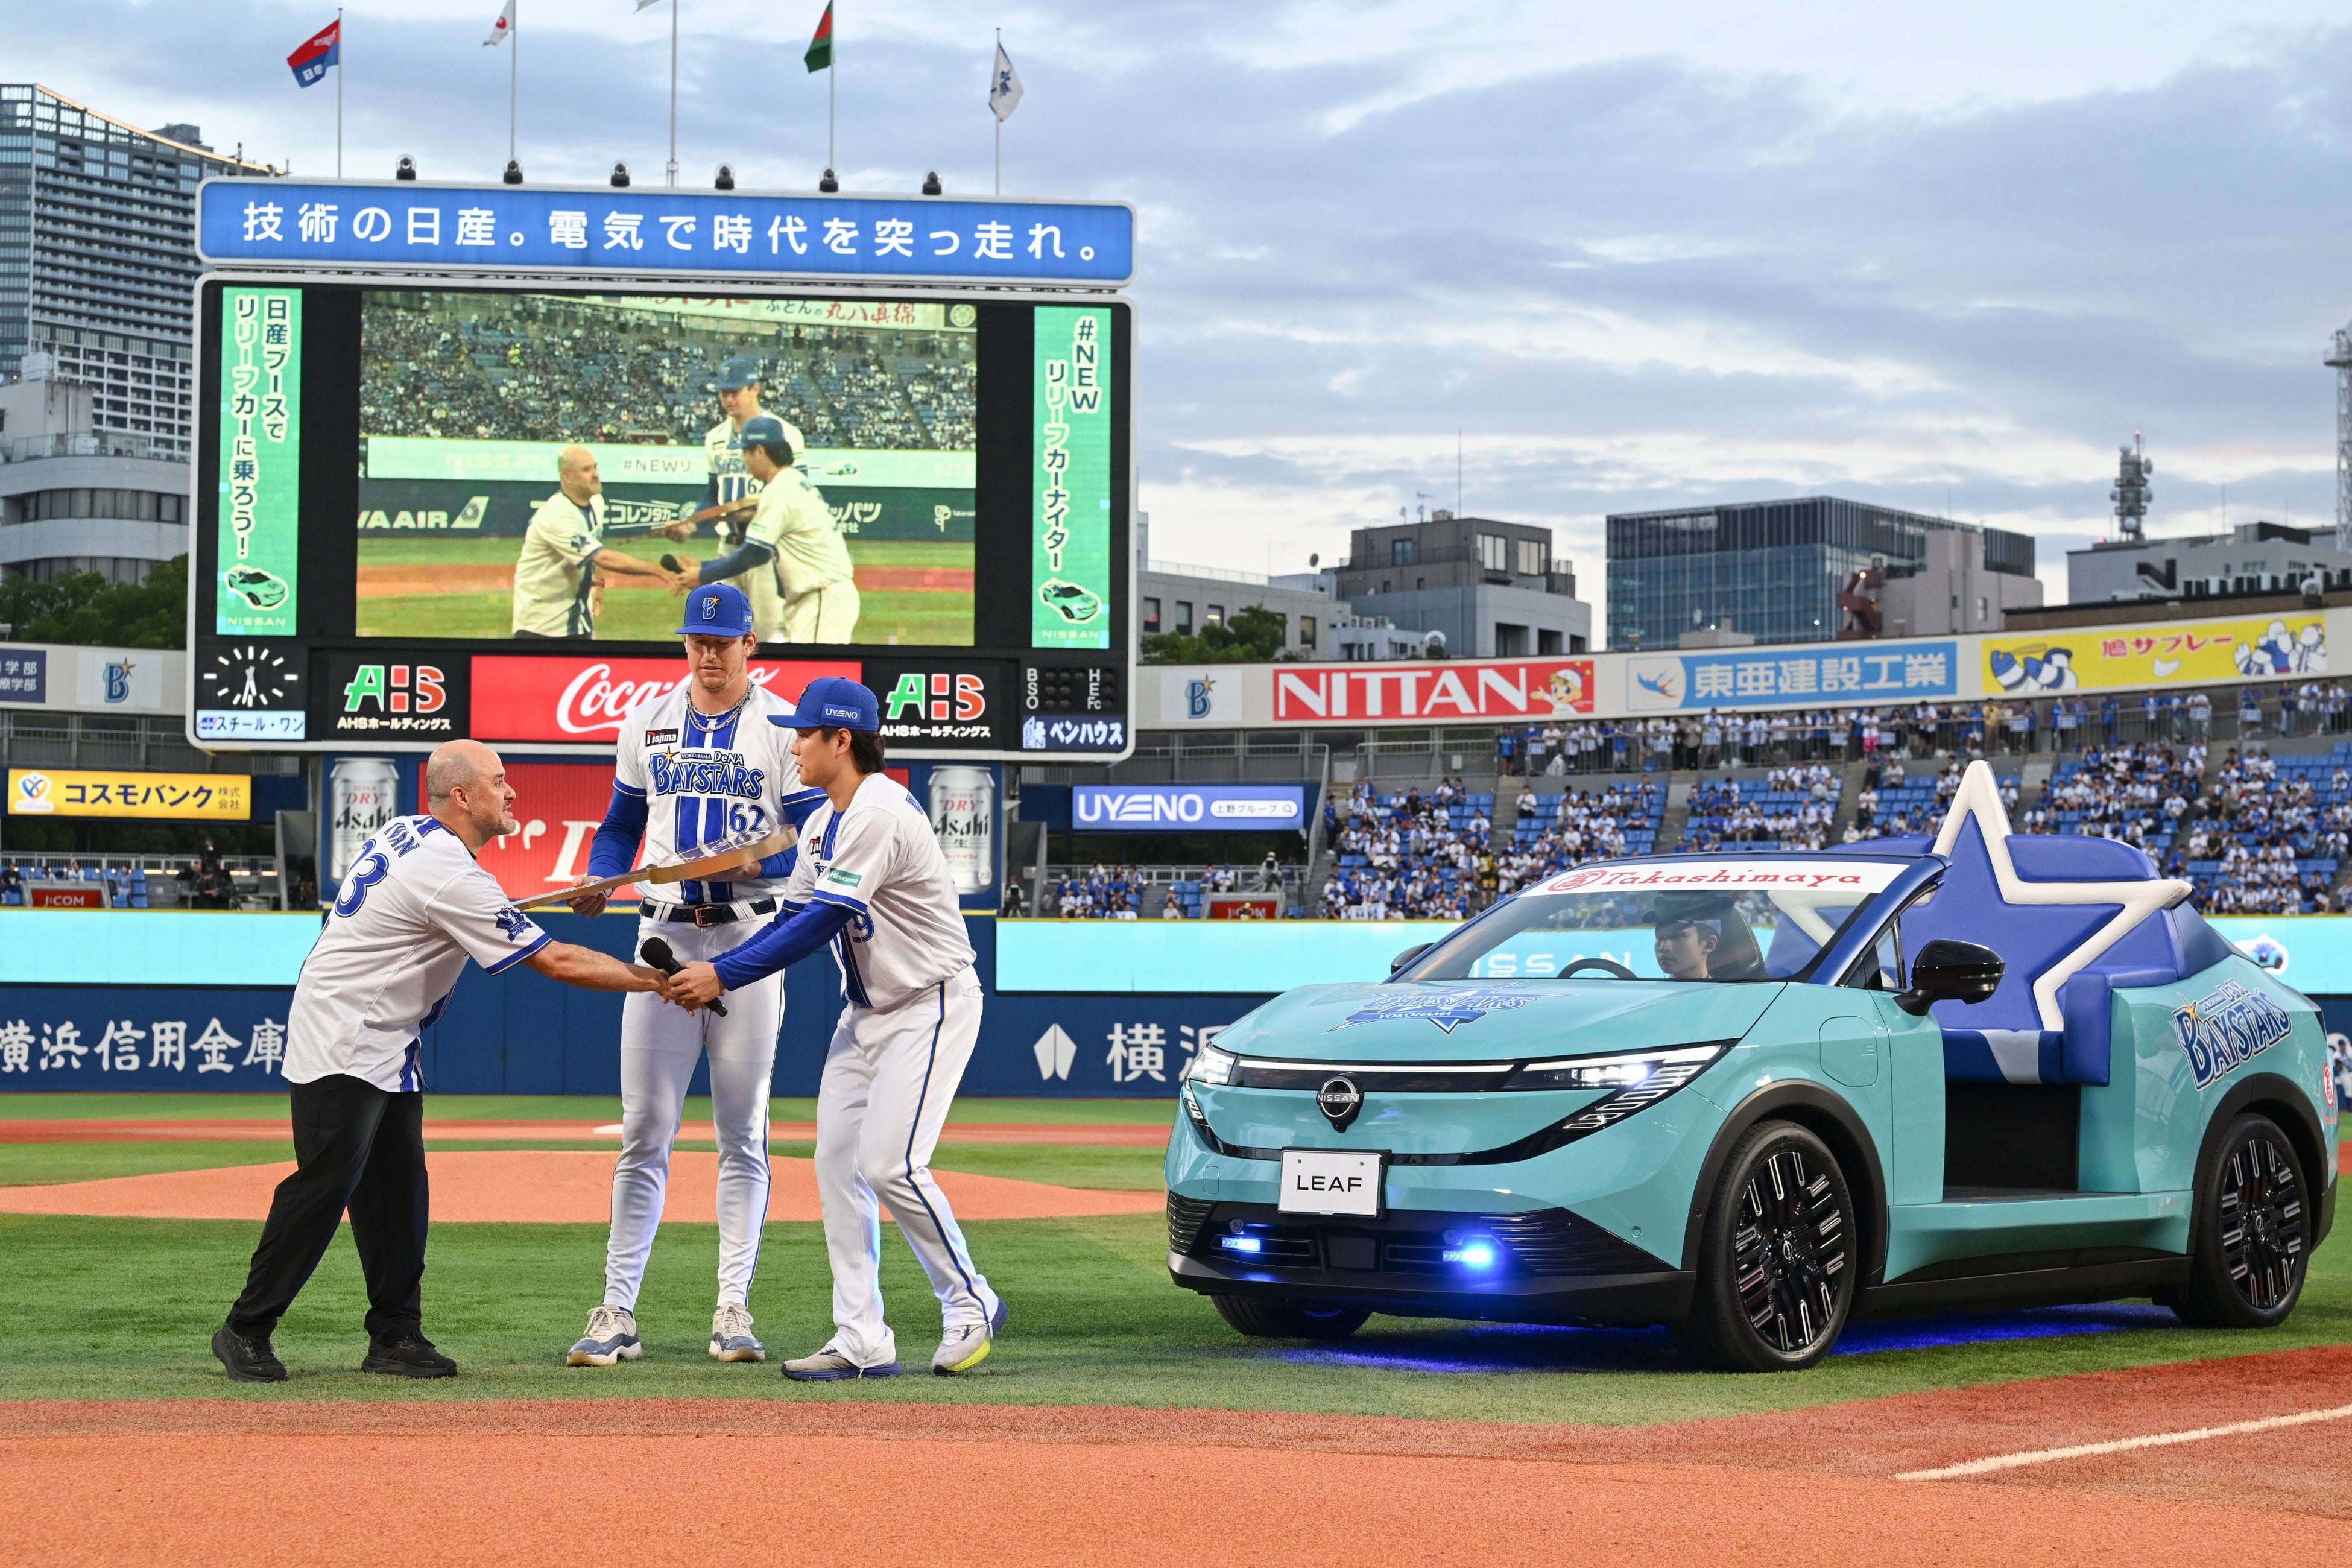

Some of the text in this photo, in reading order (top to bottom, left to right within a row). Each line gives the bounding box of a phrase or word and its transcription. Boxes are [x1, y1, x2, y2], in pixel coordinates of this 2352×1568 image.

[243, 201, 1096, 261] 技術の日産。電気で時代を突っ走れ。
[265, 298, 288, 439] 日産ブースで
[1072, 320, 1099, 411] #NEW
[446, 453, 550, 470] NISSAN
[1045, 362, 1069, 568] リリーフカーナイター
[227, 616, 285, 627] NISSAN
[1042, 630, 1099, 640] NISSAN
[1027, 668, 1038, 682] B
[1089, 668, 1101, 683] H
[1695, 652, 1946, 698] 東亜建設工業
[1027, 681, 1038, 695] S
[1089, 682, 1100, 697] E
[1278, 666, 1527, 717] NITTAN
[825, 707, 858, 719] UYENO
[217, 716, 304, 733] スチール・ワン
[337, 716, 452, 730] AHSホールディングス
[879, 724, 991, 738] AHSホールディングス
[681, 750, 745, 766] YOKOHAMA DeNA
[648, 751, 765, 800] BAYSTARS
[65, 783, 213, 808] コスモバンク
[1078, 794, 1204, 822] UYENO
[1216, 804, 1278, 815] 上野グループ
[336, 806, 392, 829] Asahi
[728, 802, 765, 835] 62
[934, 812, 988, 836] Asahi
[829, 871, 859, 884] Hisense
[1600, 869, 1862, 887] Takashimaya
[1378, 1011, 1453, 1020] YOKOHAMA
[0, 1017, 286, 1075] 横浜信用金庫
[2172, 989, 2292, 1091] BAYSTARS
[1297, 1175, 1362, 1192] LEAF
